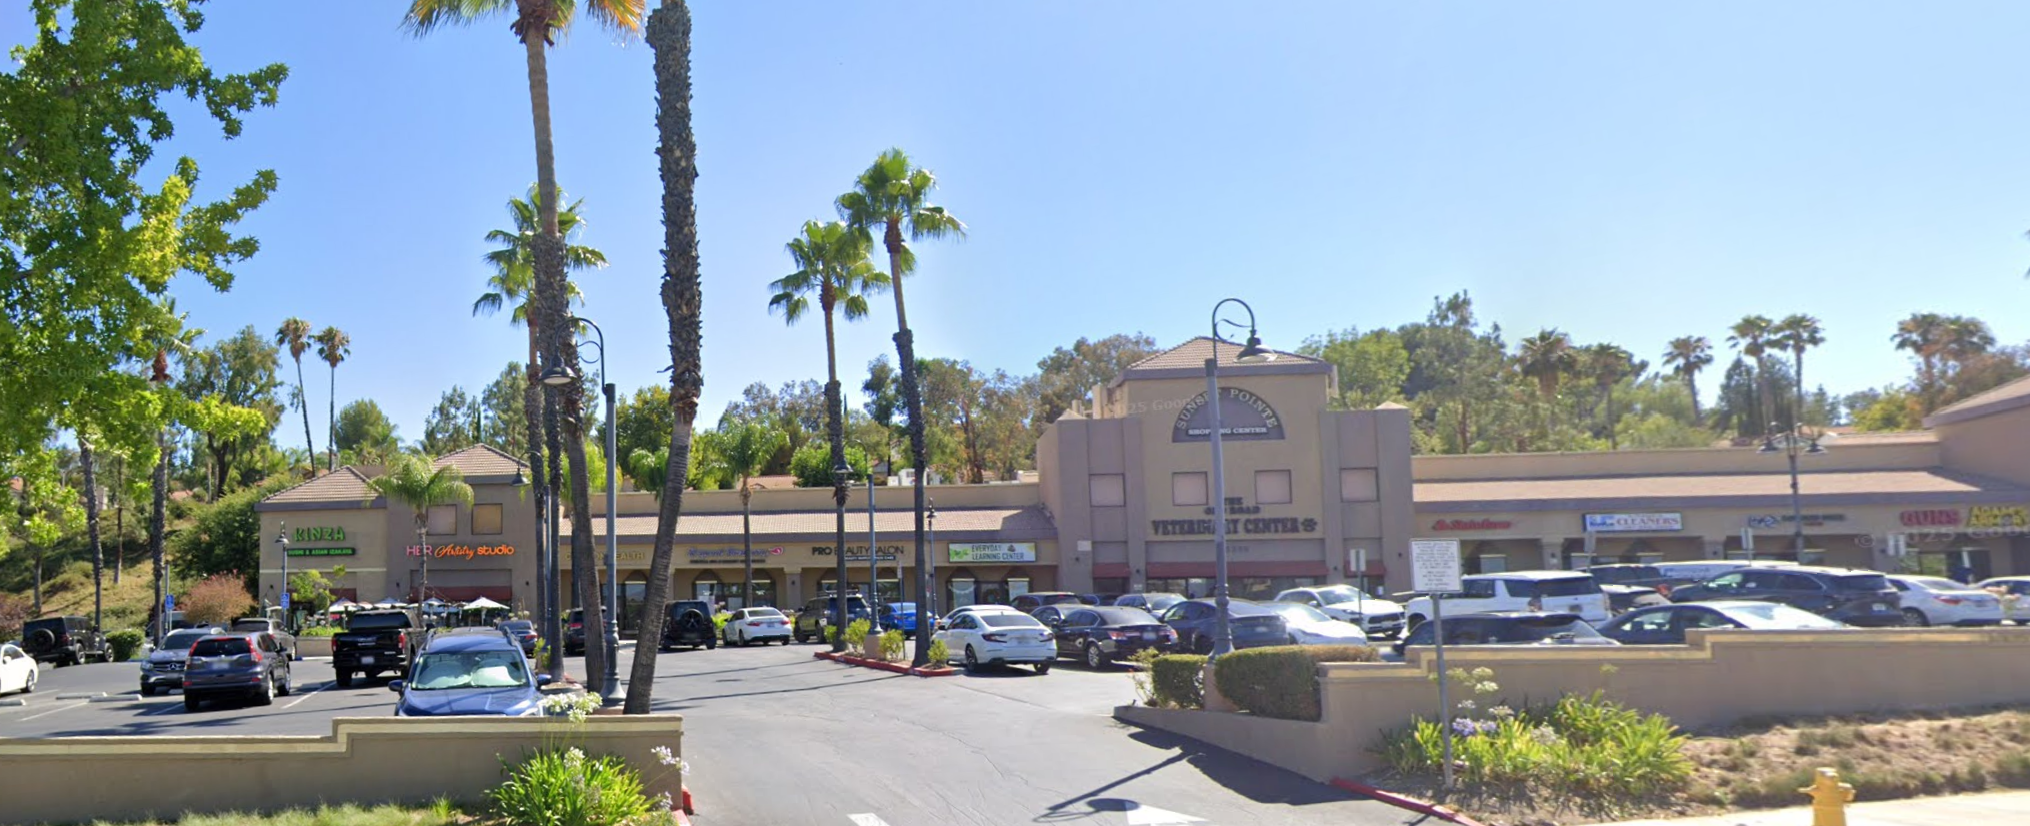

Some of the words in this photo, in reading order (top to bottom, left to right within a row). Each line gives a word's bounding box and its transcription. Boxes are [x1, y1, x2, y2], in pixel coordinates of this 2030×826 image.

[1229, 388, 1278, 428] POINTE
[1616, 517, 1679, 526] CLEANERS
[1901, 509, 1961, 527] GUNS
[1244, 517, 1300, 534] CENTER
[294, 526, 346, 542] KINZA
[477, 544, 515, 555] studio
[812, 547, 833, 555] PRO
[1002, 552, 1024, 560] CENTER
